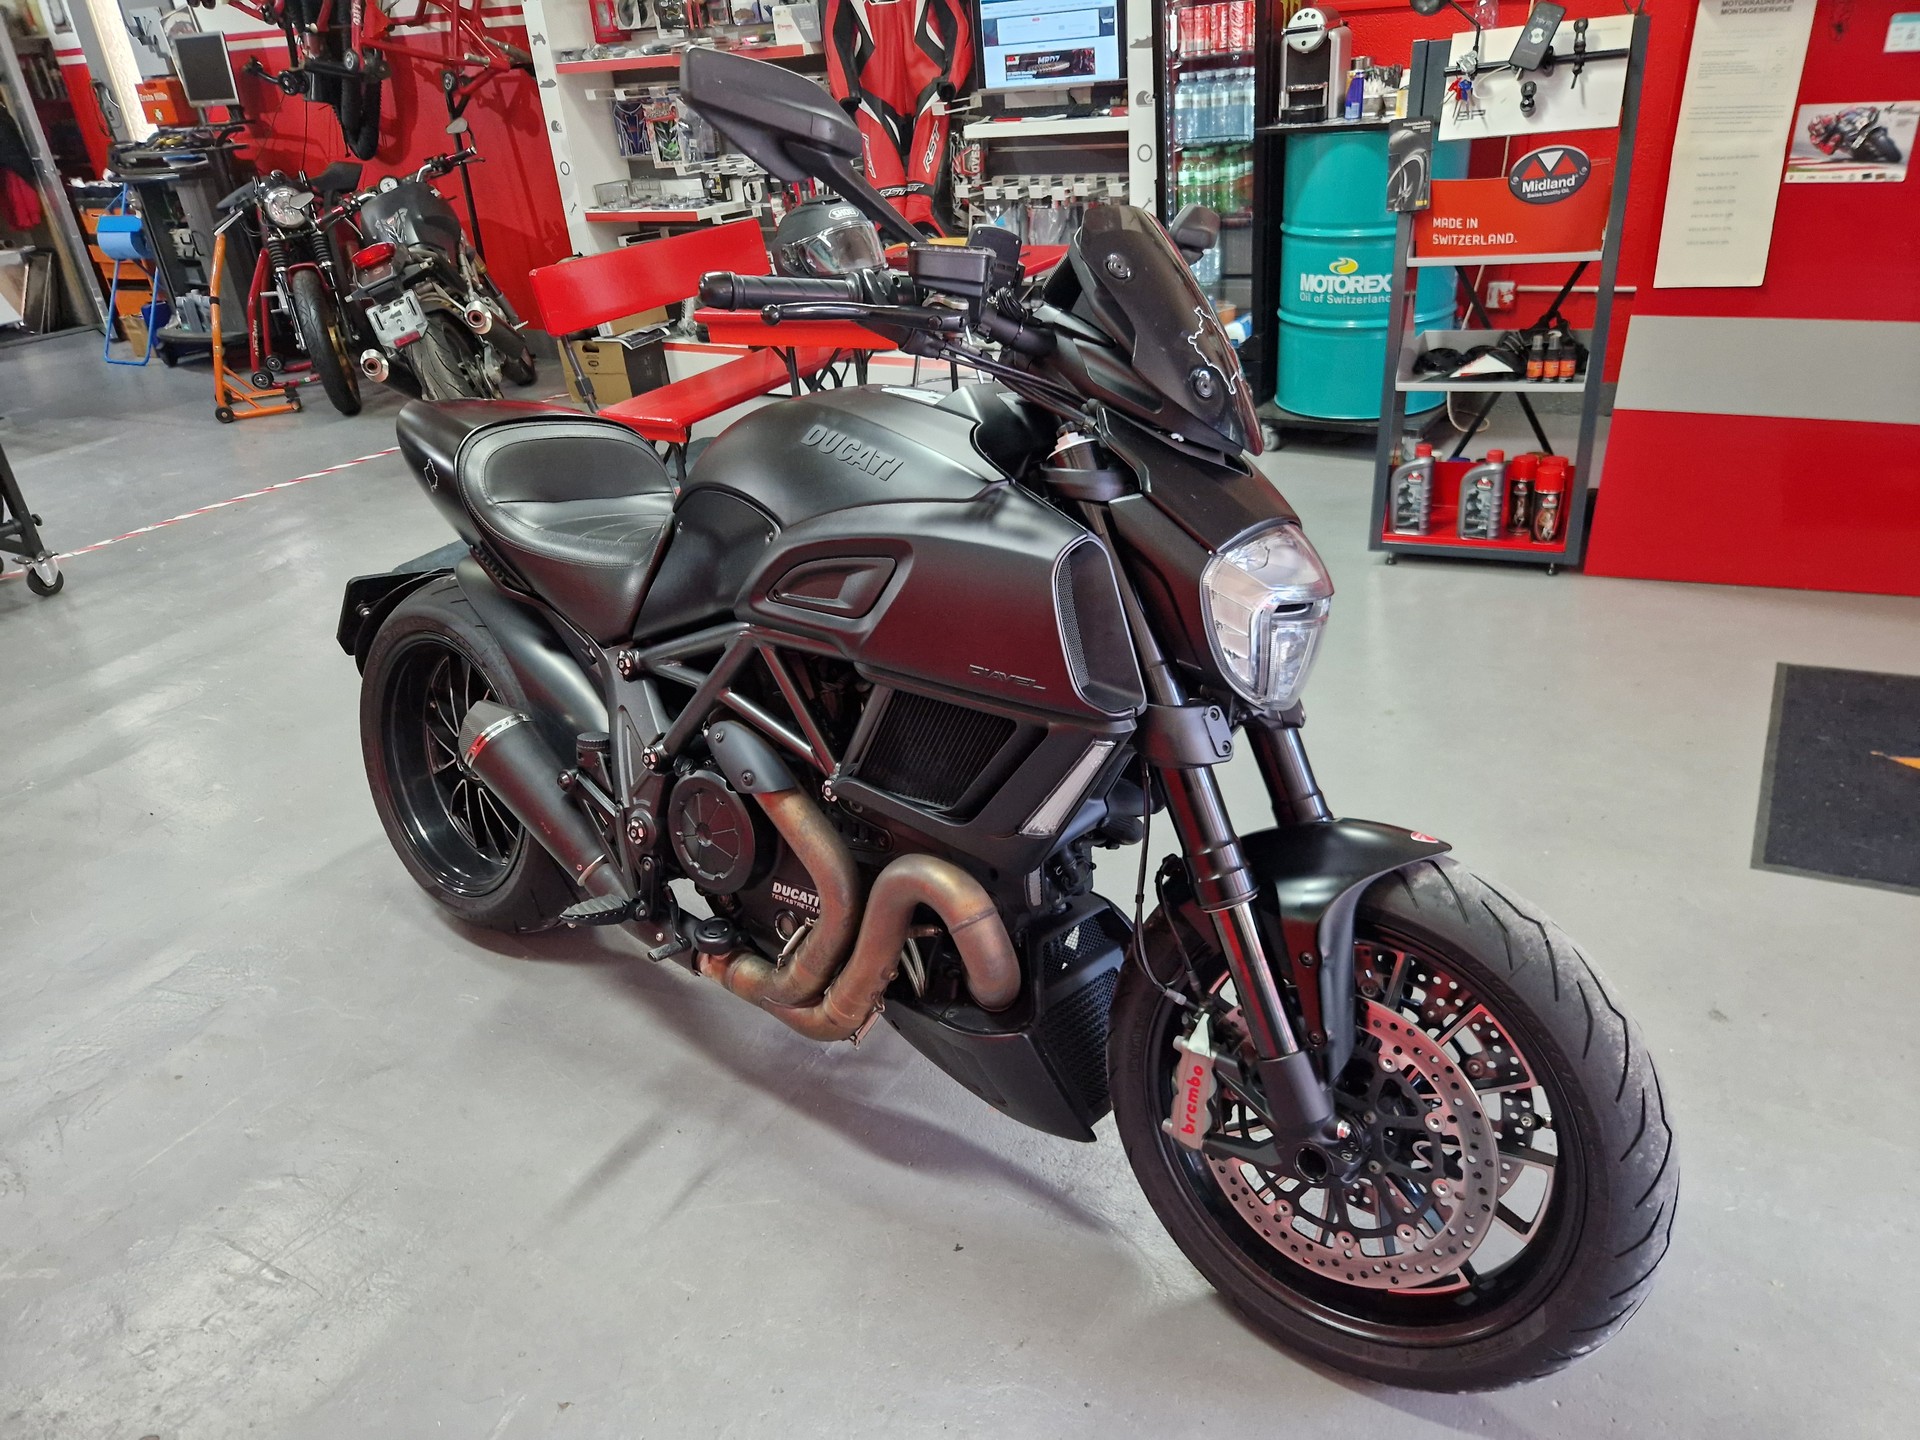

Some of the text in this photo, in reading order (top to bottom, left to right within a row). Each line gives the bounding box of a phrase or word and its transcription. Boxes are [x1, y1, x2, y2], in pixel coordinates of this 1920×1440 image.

[1720, 5, 1793, 15] MONTAGESERVICE
[922, 119, 940, 173] RST
[1521, 174, 1577, 194] Midland
[1432, 217, 1479, 229] MADE IN
[1300, 273, 1393, 294] MOTOREX
[1300, 291, 1311, 302] Oil
[1313, 294, 1324, 304] of
[800, 424, 904, 481] DUCATI
[772, 882, 820, 907] DUCATI
[1180, 1065, 1204, 1134] brembo
